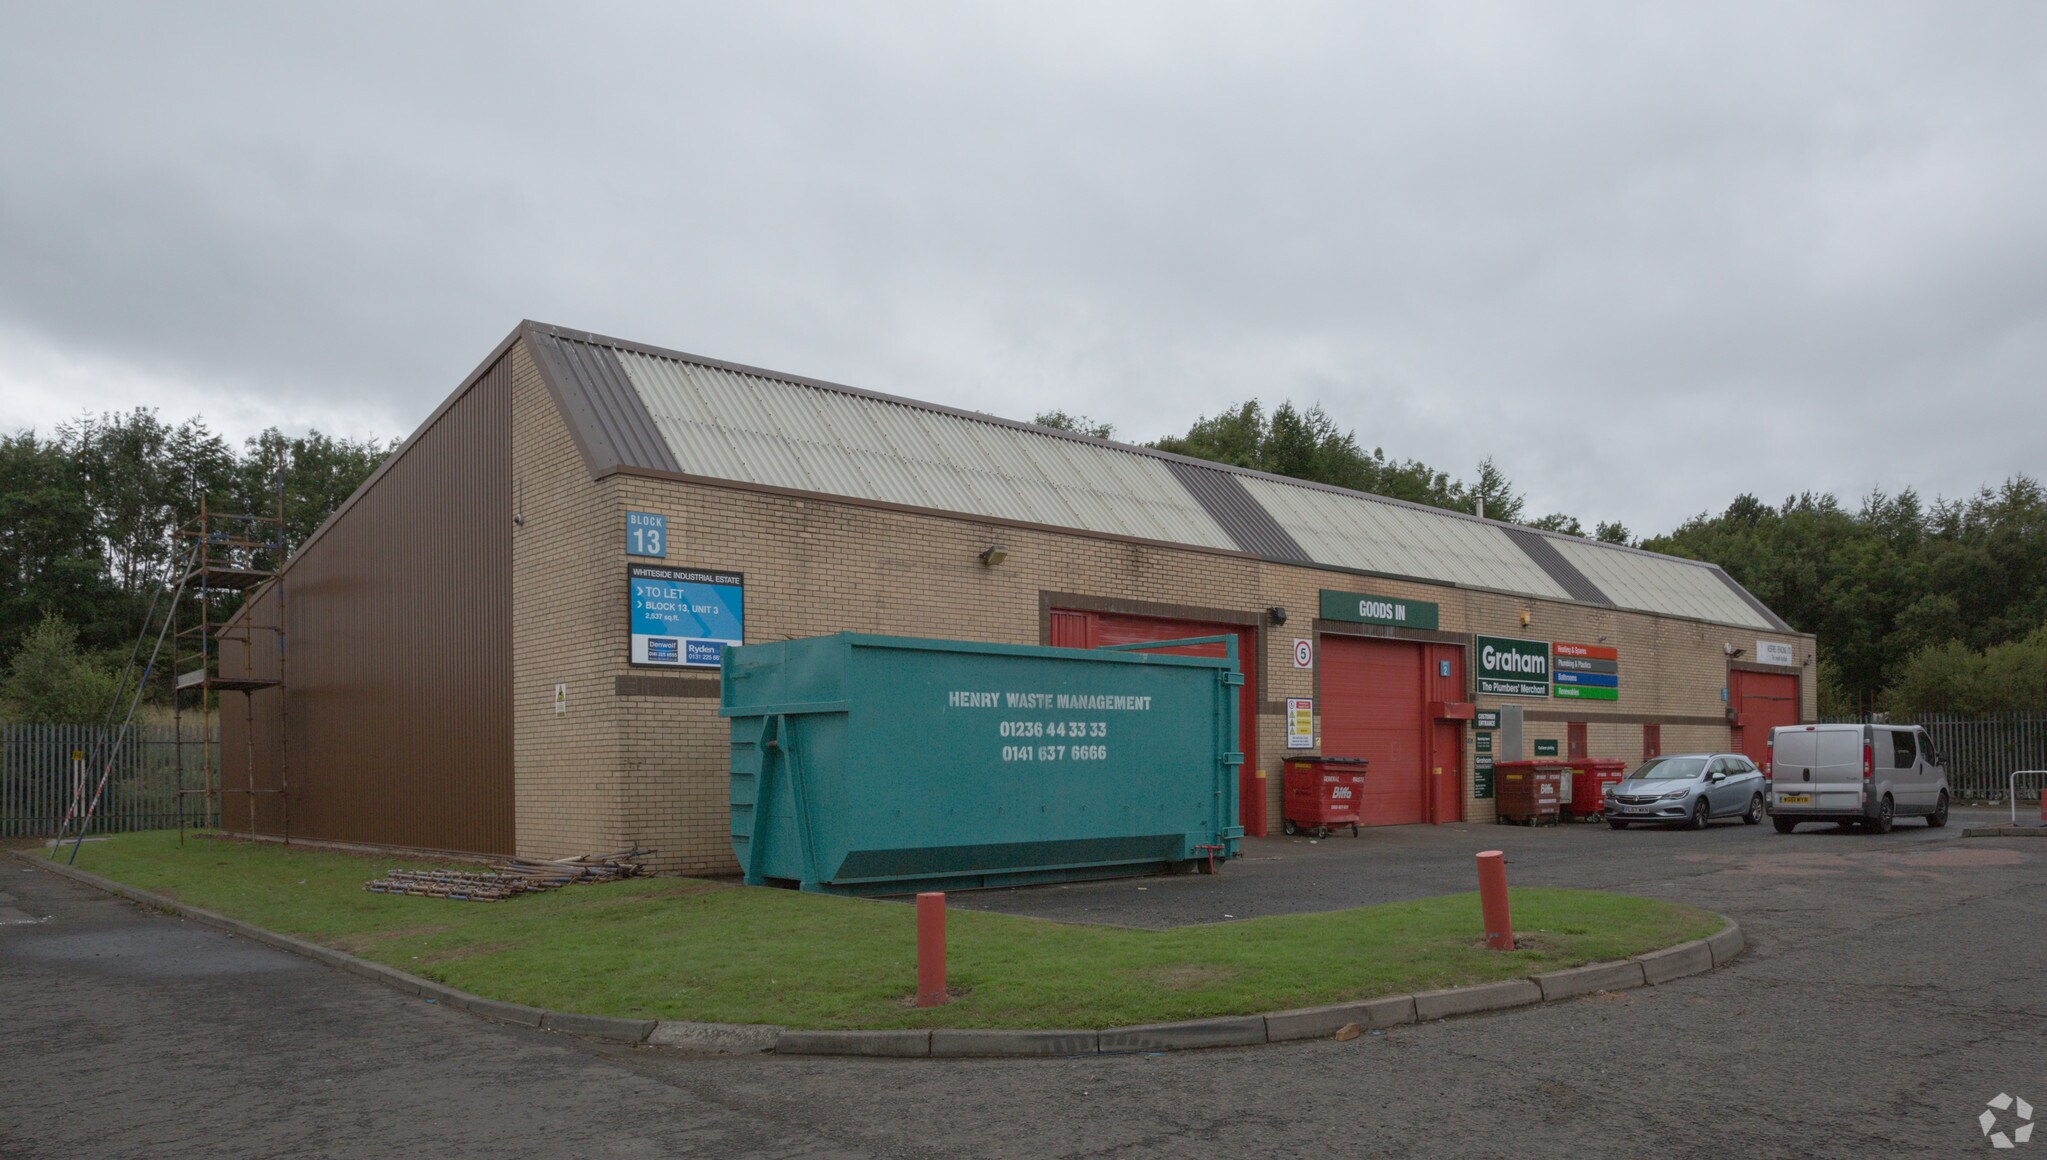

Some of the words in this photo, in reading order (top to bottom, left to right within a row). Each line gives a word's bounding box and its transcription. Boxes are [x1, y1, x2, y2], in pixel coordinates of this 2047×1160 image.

[630, 515, 662, 527] BLOCK
[633, 528, 661, 554] 13
[632, 568, 672, 579] WHITESIDE
[673, 572, 714, 582] INDUSTRIAL
[715, 576, 740, 584] ESTATE
[645, 587, 661, 598] TO
[663, 588, 684, 599] LET
[645, 601, 676, 611] BLOCK
[678, 604, 690, 613] 13,
[691, 605, 712, 613] UNIT
[713, 606, 719, 615] 3
[1359, 600, 1393, 620] GOODS
[1395, 604, 1406, 621] IN
[688, 644, 715, 654] Ryden
[1300, 648, 1306, 660] 5
[1557, 645, 1571, 655] Heating
[1482, 645, 1546, 674] Graham
[1558, 659, 1574, 669] Plumbing
[1482, 682, 1492, 691] The
[1493, 683, 1520, 693] Plumbers'
[1520, 685, 1546, 694] Merchant
[949, 691, 1000, 708] HENRY
[1006, 693, 1053, 709] WASTE
[1057, 694, 1151, 711] MANAGEMENT
[1000, 721, 1043, 738] 01236
[1046, 722, 1066, 737] 44
[1069, 722, 1086, 737] 33
[1089, 722, 1107, 737] 33
[1002, 746, 1034, 762] 0141
[1038, 746, 1065, 762] 637
[1071, 746, 1107, 761] 6666
